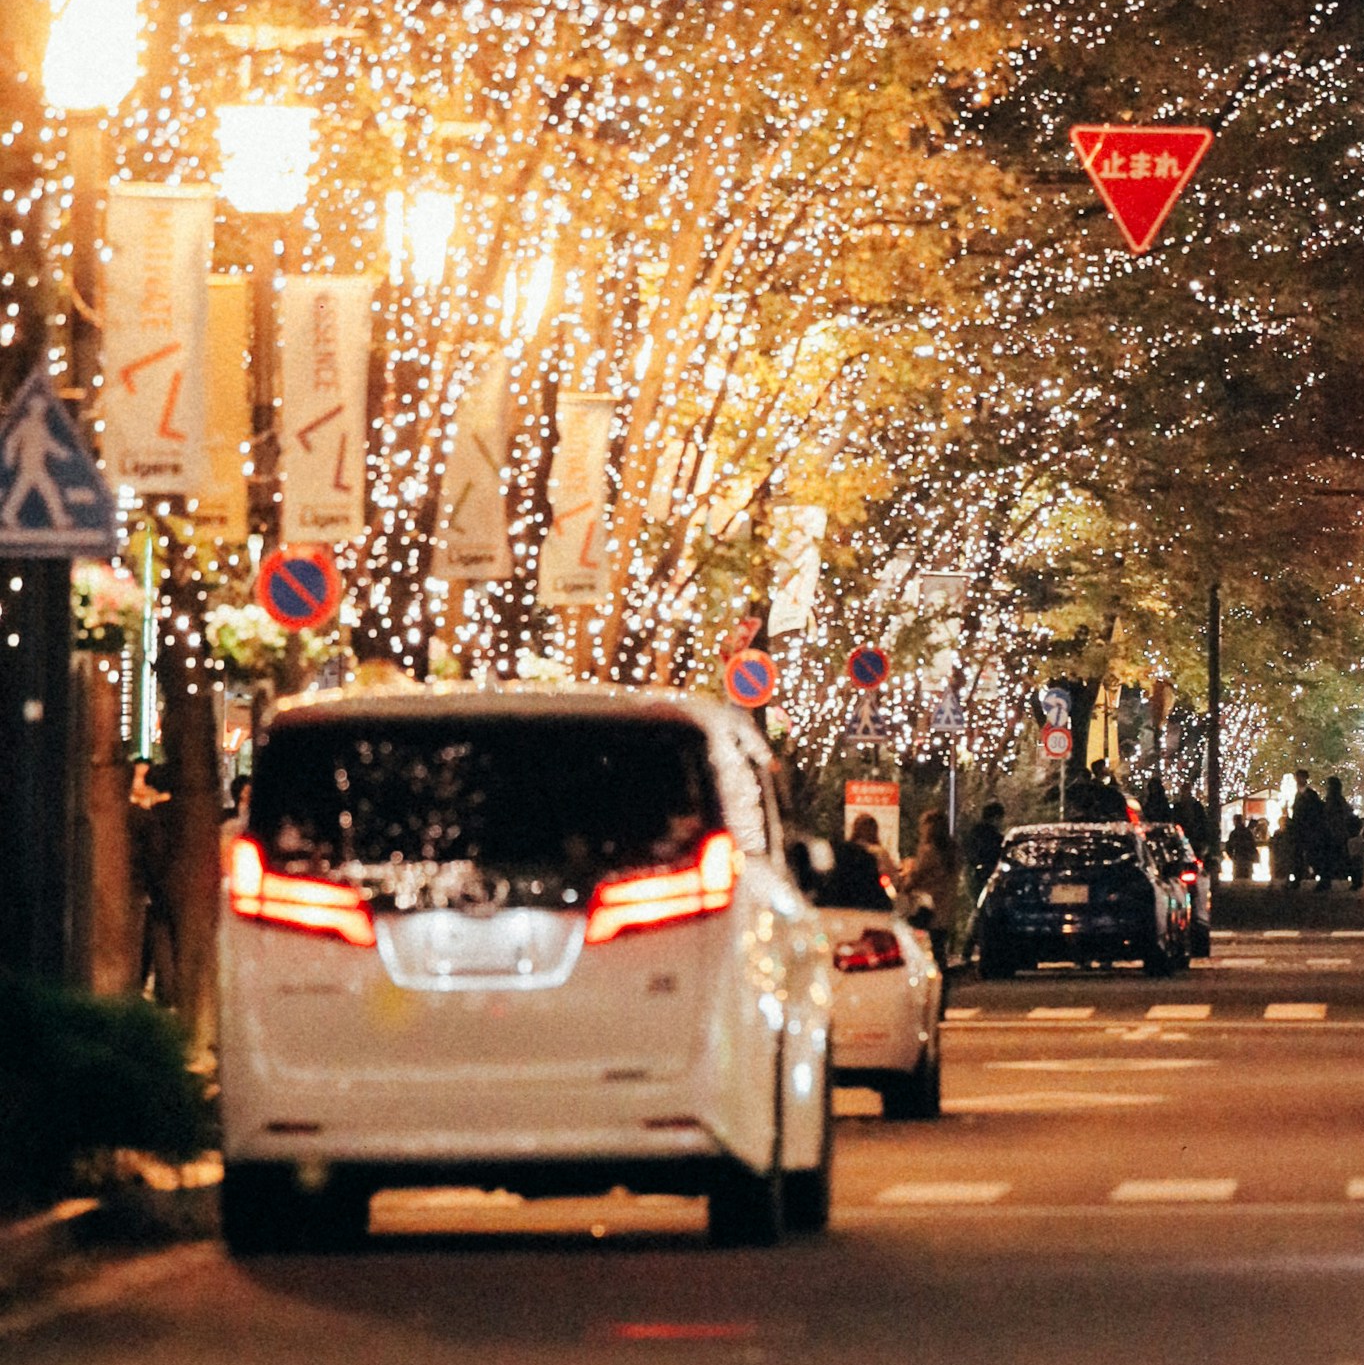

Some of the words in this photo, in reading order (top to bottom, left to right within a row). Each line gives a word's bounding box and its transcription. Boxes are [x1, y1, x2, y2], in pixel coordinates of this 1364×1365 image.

[1100, 150, 1182, 179] 止まれ
[1051, 735, 1067, 749] 30
